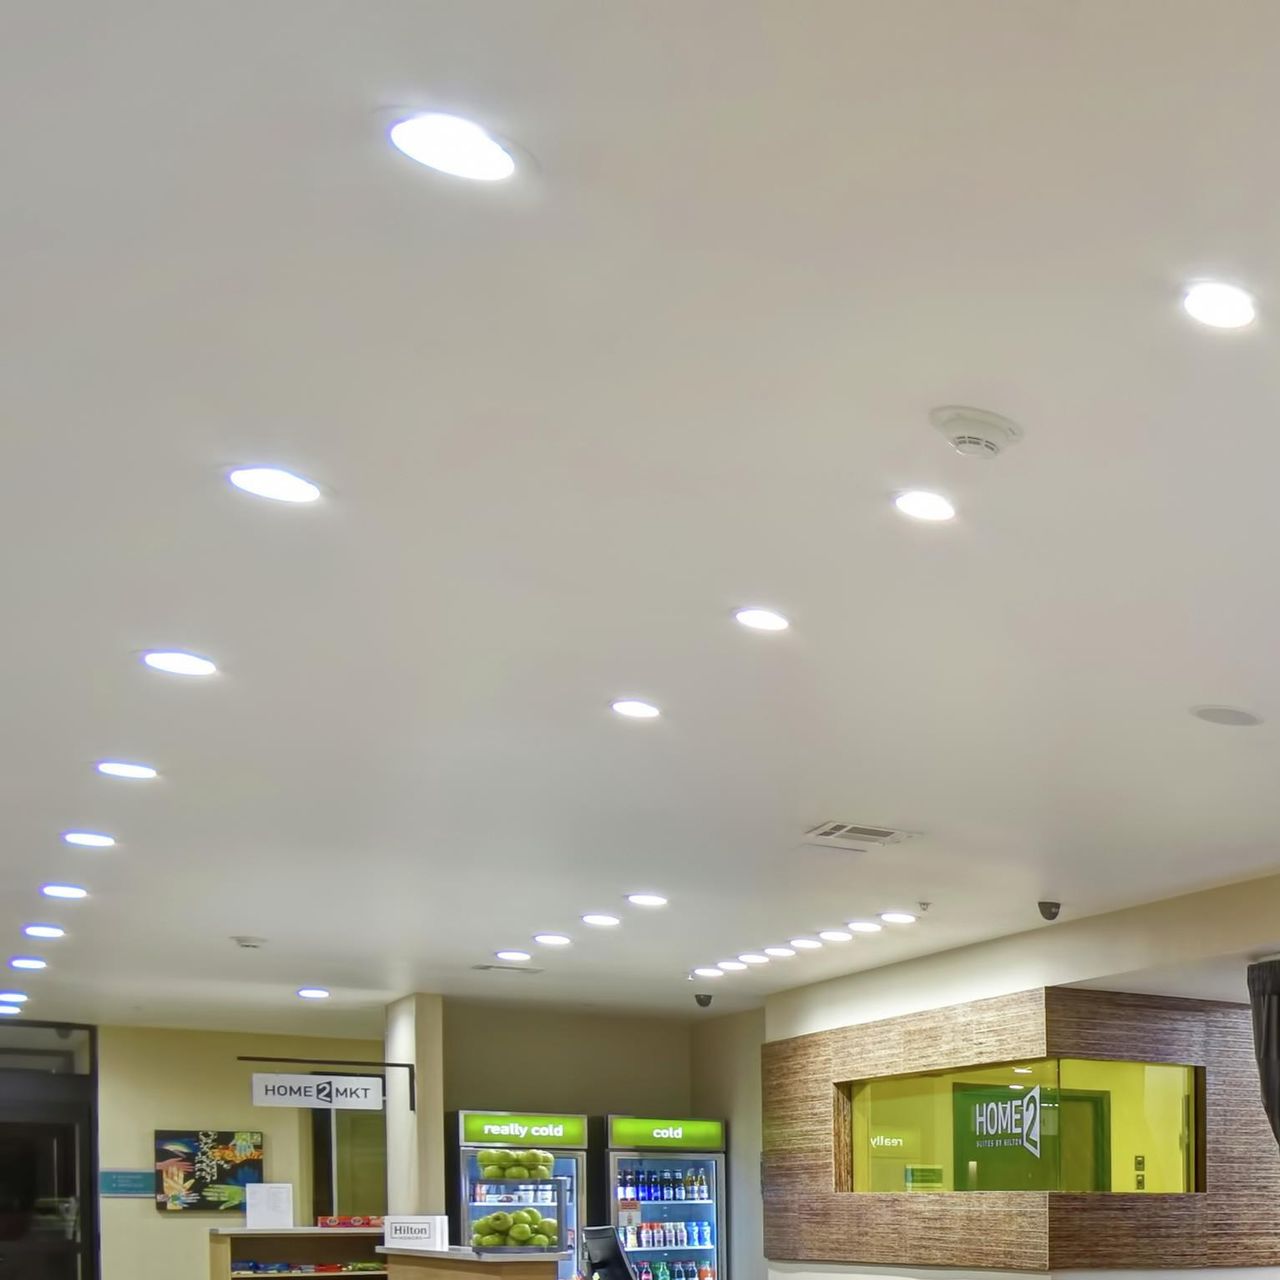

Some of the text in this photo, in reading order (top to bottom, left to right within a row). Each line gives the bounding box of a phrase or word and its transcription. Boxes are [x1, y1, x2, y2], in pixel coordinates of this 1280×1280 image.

[483, 1122, 564, 1138] really cold
[652, 1126, 683, 1139] cold
[394, 1225, 428, 1235] Hilton
